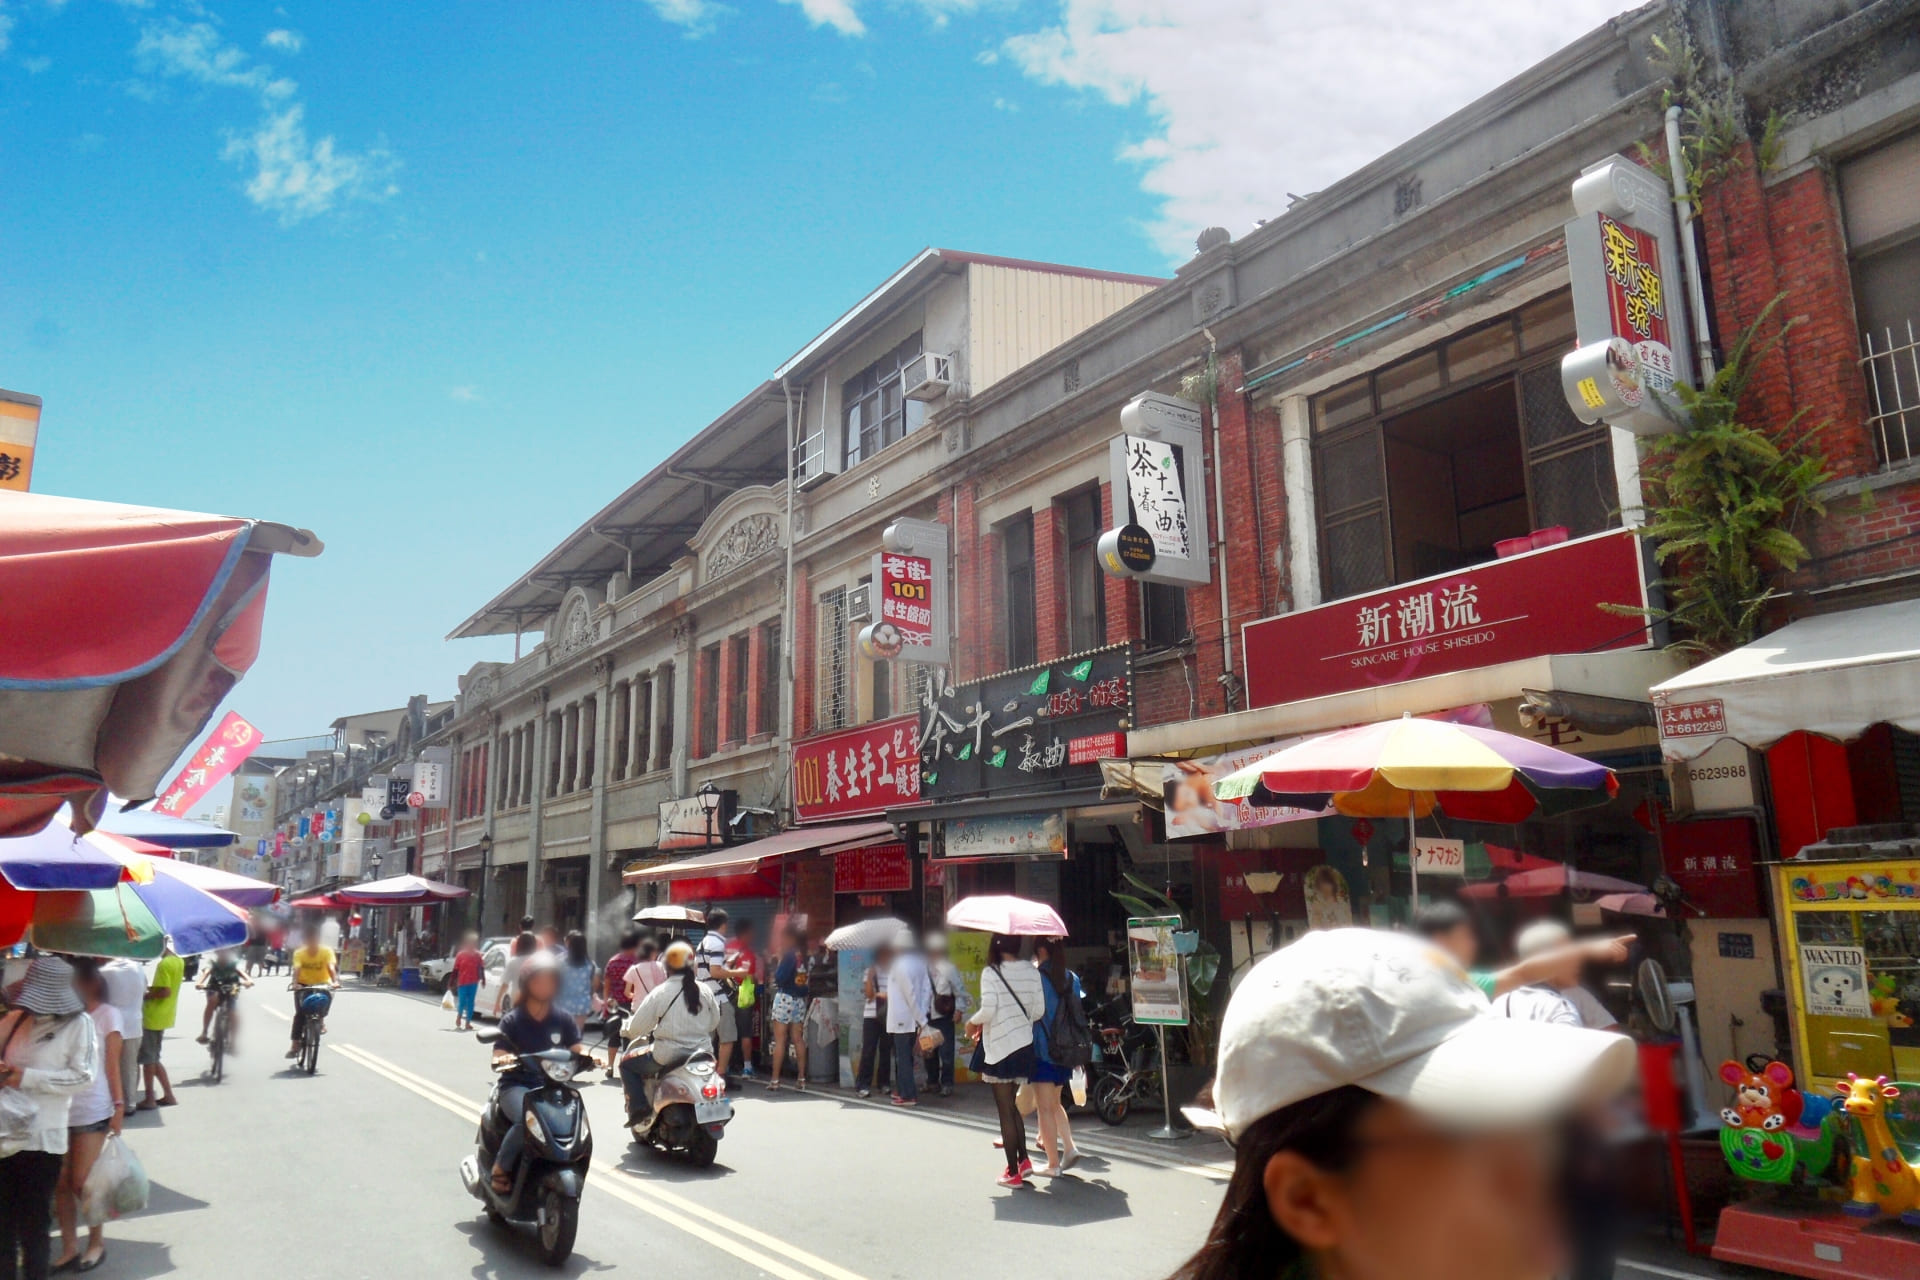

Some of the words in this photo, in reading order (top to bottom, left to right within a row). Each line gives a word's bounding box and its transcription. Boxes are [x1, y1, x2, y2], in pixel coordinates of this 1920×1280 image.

[1602, 219, 1664, 337] 新潮流
[881, 557, 932, 581] 老街
[890, 581, 926, 600] 101
[883, 599, 931, 626] 養生饅頭
[1356, 583, 1482, 647] 新潮流
[1350, 650, 1400, 669] SKINCARE
[1404, 641, 1440, 658] HOUSE
[1443, 630, 1496, 651] SHISEIDO
[1665, 704, 1719, 723] 大順帆布
[1677, 720, 1723, 734] 6612298
[795, 755, 823, 806] 101
[825, 740, 895, 804] 養生手工
[1689, 765, 1747, 782] 6623988
[1427, 846, 1462, 865] ナマカシ
[1684, 855, 1737, 871] 新潮流
[1804, 949, 1863, 966] WANTED
